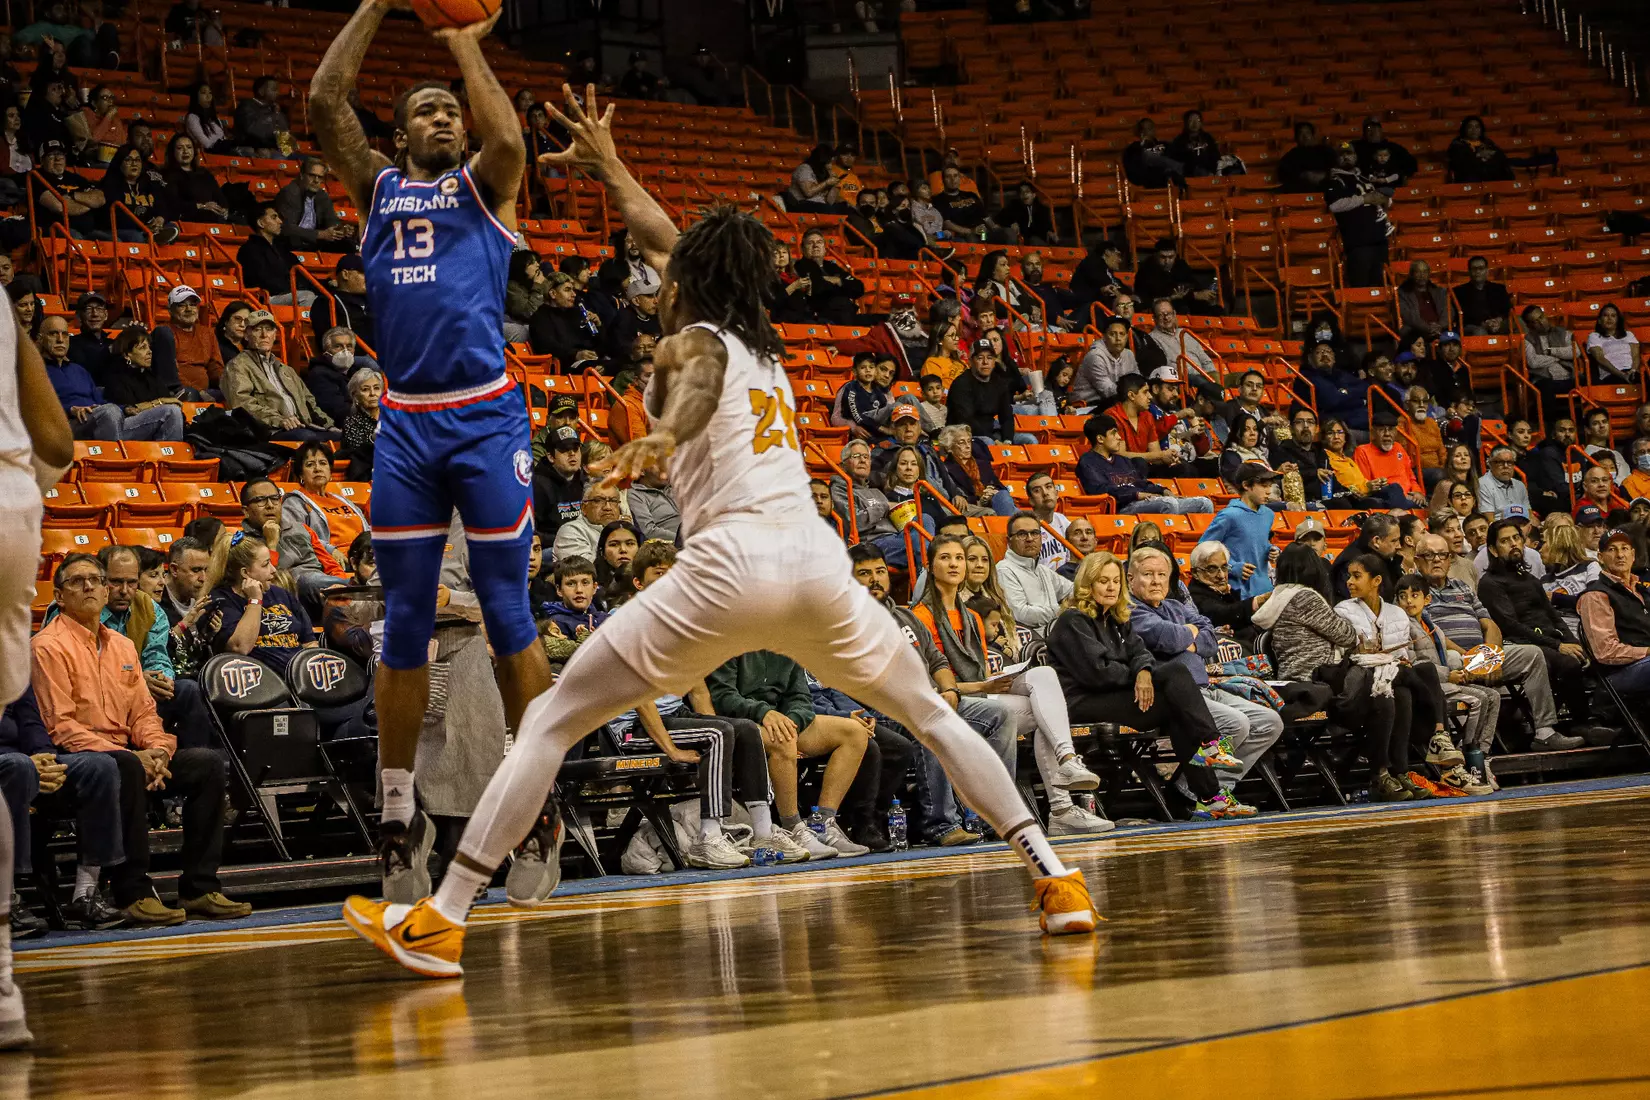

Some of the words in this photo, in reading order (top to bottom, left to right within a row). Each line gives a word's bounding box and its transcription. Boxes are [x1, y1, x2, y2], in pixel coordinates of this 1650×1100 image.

[393, 218, 435, 260] 13
[391, 264, 437, 285] TECH
[163, 447, 172, 455] 10
[221, 659, 262, 698] UTEP
[306, 653, 346, 692] UTEP
[615, 757, 661, 770] MINERS
